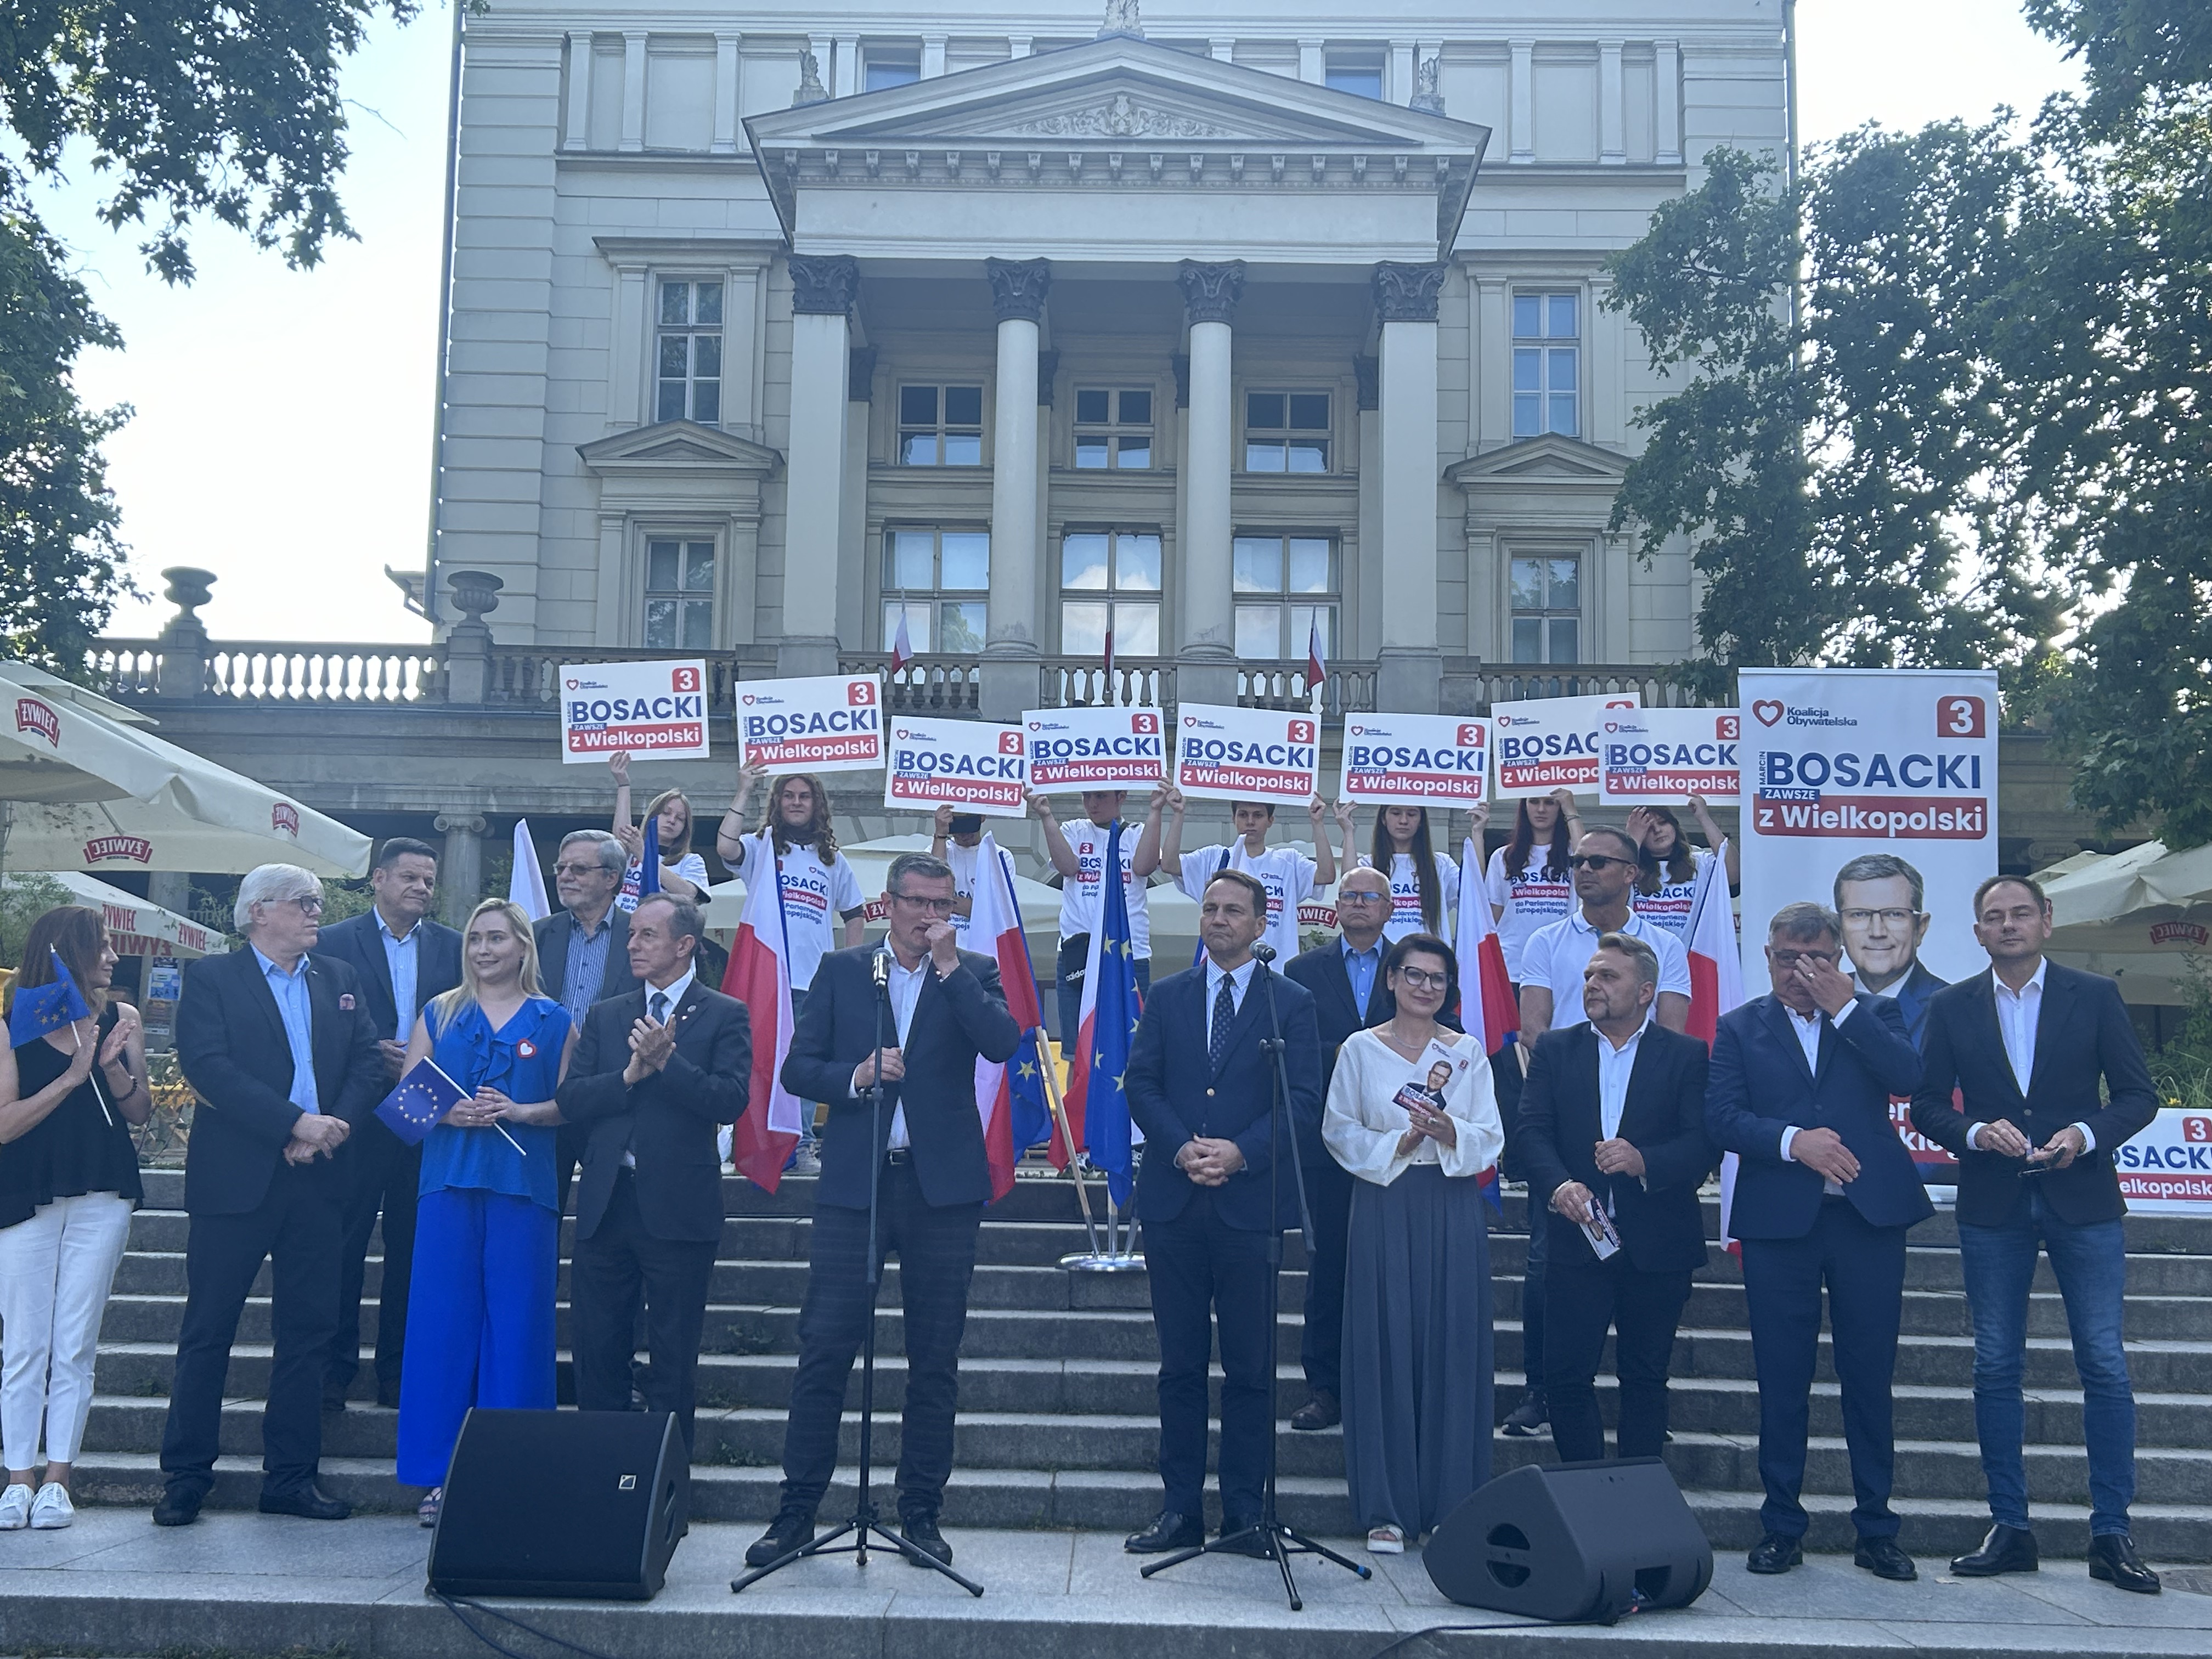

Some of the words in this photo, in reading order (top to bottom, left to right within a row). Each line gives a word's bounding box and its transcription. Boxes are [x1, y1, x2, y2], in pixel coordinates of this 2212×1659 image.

[679, 670, 693, 690] 3
[854, 684, 868, 703] 3
[21, 700, 55, 735] ŻYWIEC
[572, 696, 702, 723] BOSACKI
[1787, 707, 1829, 717] Koalicja
[1949, 699, 1973, 734] 3
[748, 709, 877, 737] BOSACKI
[1138, 715, 1152, 732] 3
[1294, 722, 1308, 741] 3
[1724, 718, 1737, 737] 3
[1786, 716, 1858, 727] Obywatelska
[571, 736, 580, 747] z
[584, 726, 699, 748] Wielkopolski
[1005, 734, 1019, 752] 3
[1464, 726, 1478, 745] 3
[1504, 731, 1599, 759] BOSAC
[761, 739, 875, 760] Wielkopolski
[1034, 737, 1160, 759] BOSACKI
[1187, 737, 1314, 768] BOSACKI
[1353, 746, 1484, 771] BOSACKI
[1610, 744, 1738, 765] BOSACK
[899, 750, 1024, 779] BOSACKI
[1034, 770, 1043, 780] z
[1046, 763, 1159, 780] Wielkopolski
[1504, 772, 1513, 783] z
[1516, 766, 1599, 783] Wielkopo
[1767, 752, 1980, 789] BOSACKI
[1183, 770, 1192, 781] z
[1197, 769, 1308, 791] Wielkopolski
[1350, 777, 1358, 788] z
[1363, 776, 1479, 795] Wielkopolski
[1609, 779, 1618, 789] z
[895, 782, 904, 793] z
[907, 781, 1018, 802] Wielkopolski
[1765, 789, 1815, 800] ZAWSZE
[1759, 809, 1774, 827] z
[1781, 804, 1982, 837] Wielkopolski
[1082, 844, 1090, 853] 3
[1297, 908, 1333, 922] YWIEC
[2190, 1119, 2207, 1140] 3
[2113, 1145, 2212, 1170] SACK
[2119, 1178, 2212, 1199] elkopolsk
